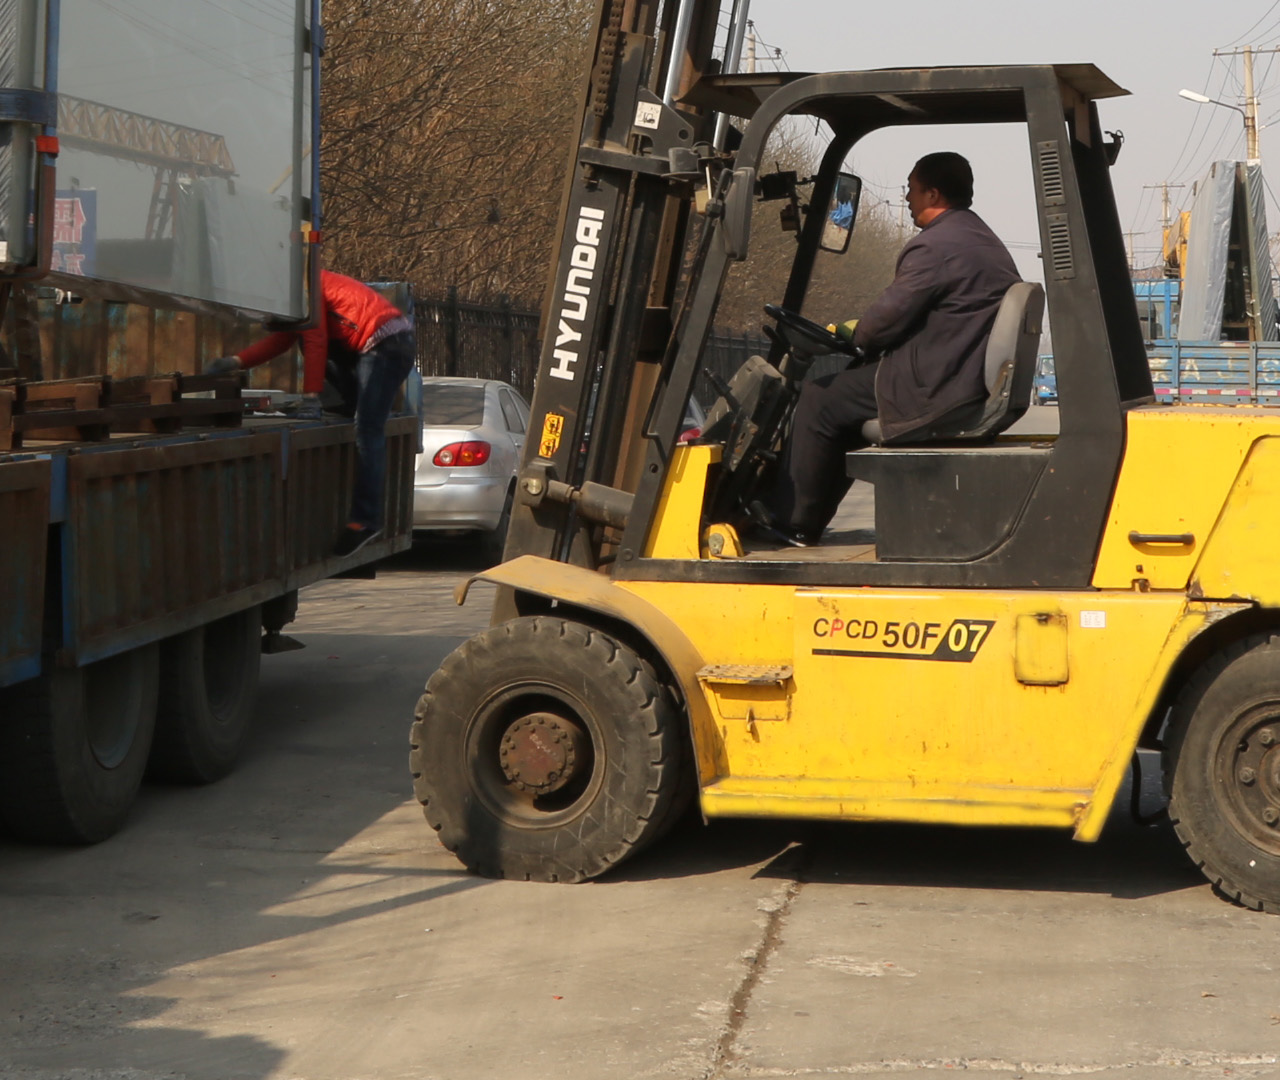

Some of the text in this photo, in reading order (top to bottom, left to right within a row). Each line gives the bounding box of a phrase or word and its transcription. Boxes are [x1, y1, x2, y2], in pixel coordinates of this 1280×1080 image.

[549, 206, 605, 381] HYUNDAI
[813, 617, 988, 653] CPCD 50F 07
